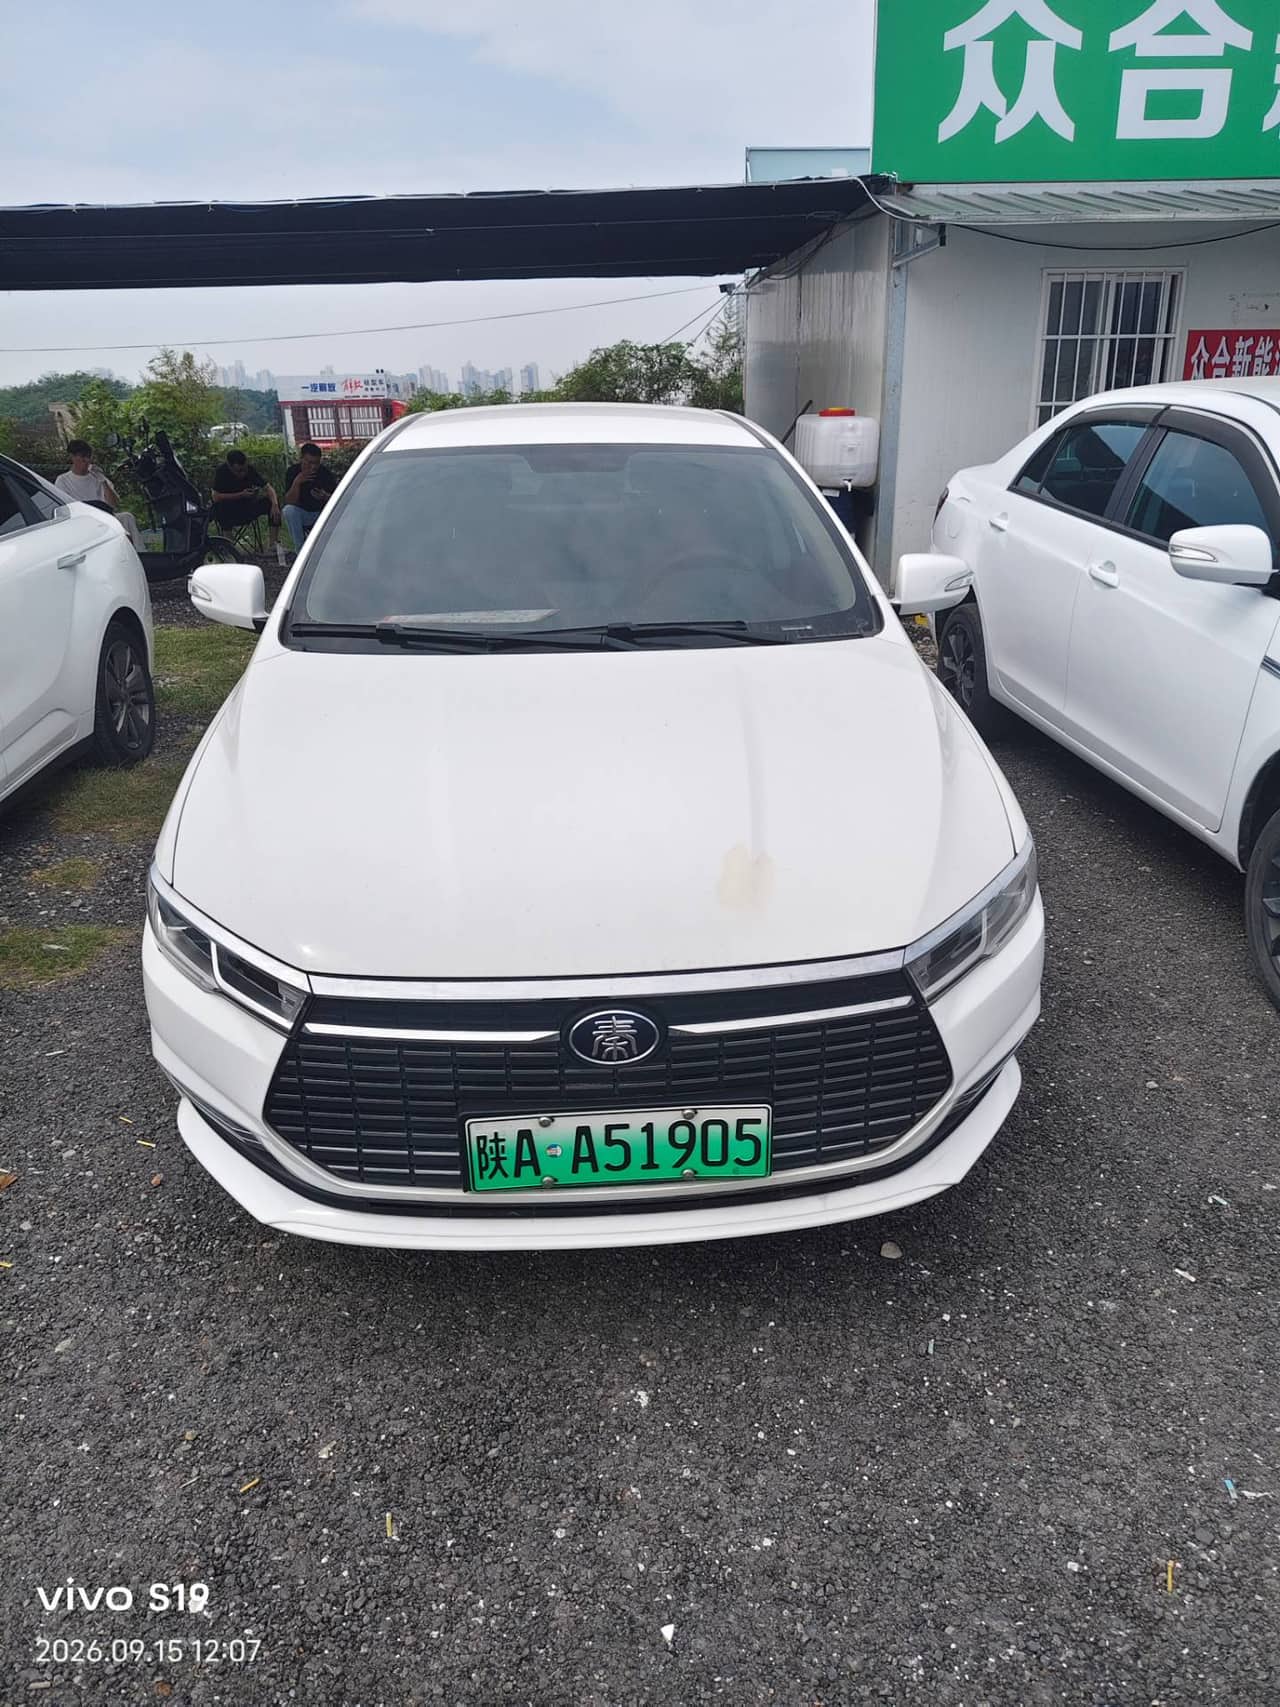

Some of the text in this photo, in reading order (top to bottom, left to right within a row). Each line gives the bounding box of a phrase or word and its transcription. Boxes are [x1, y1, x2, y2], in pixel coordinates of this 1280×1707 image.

[938, 0, 1280, 144] 众合
[1191, 335, 1280, 380] 众合新能
[592, 1015, 638, 1061] 秦
